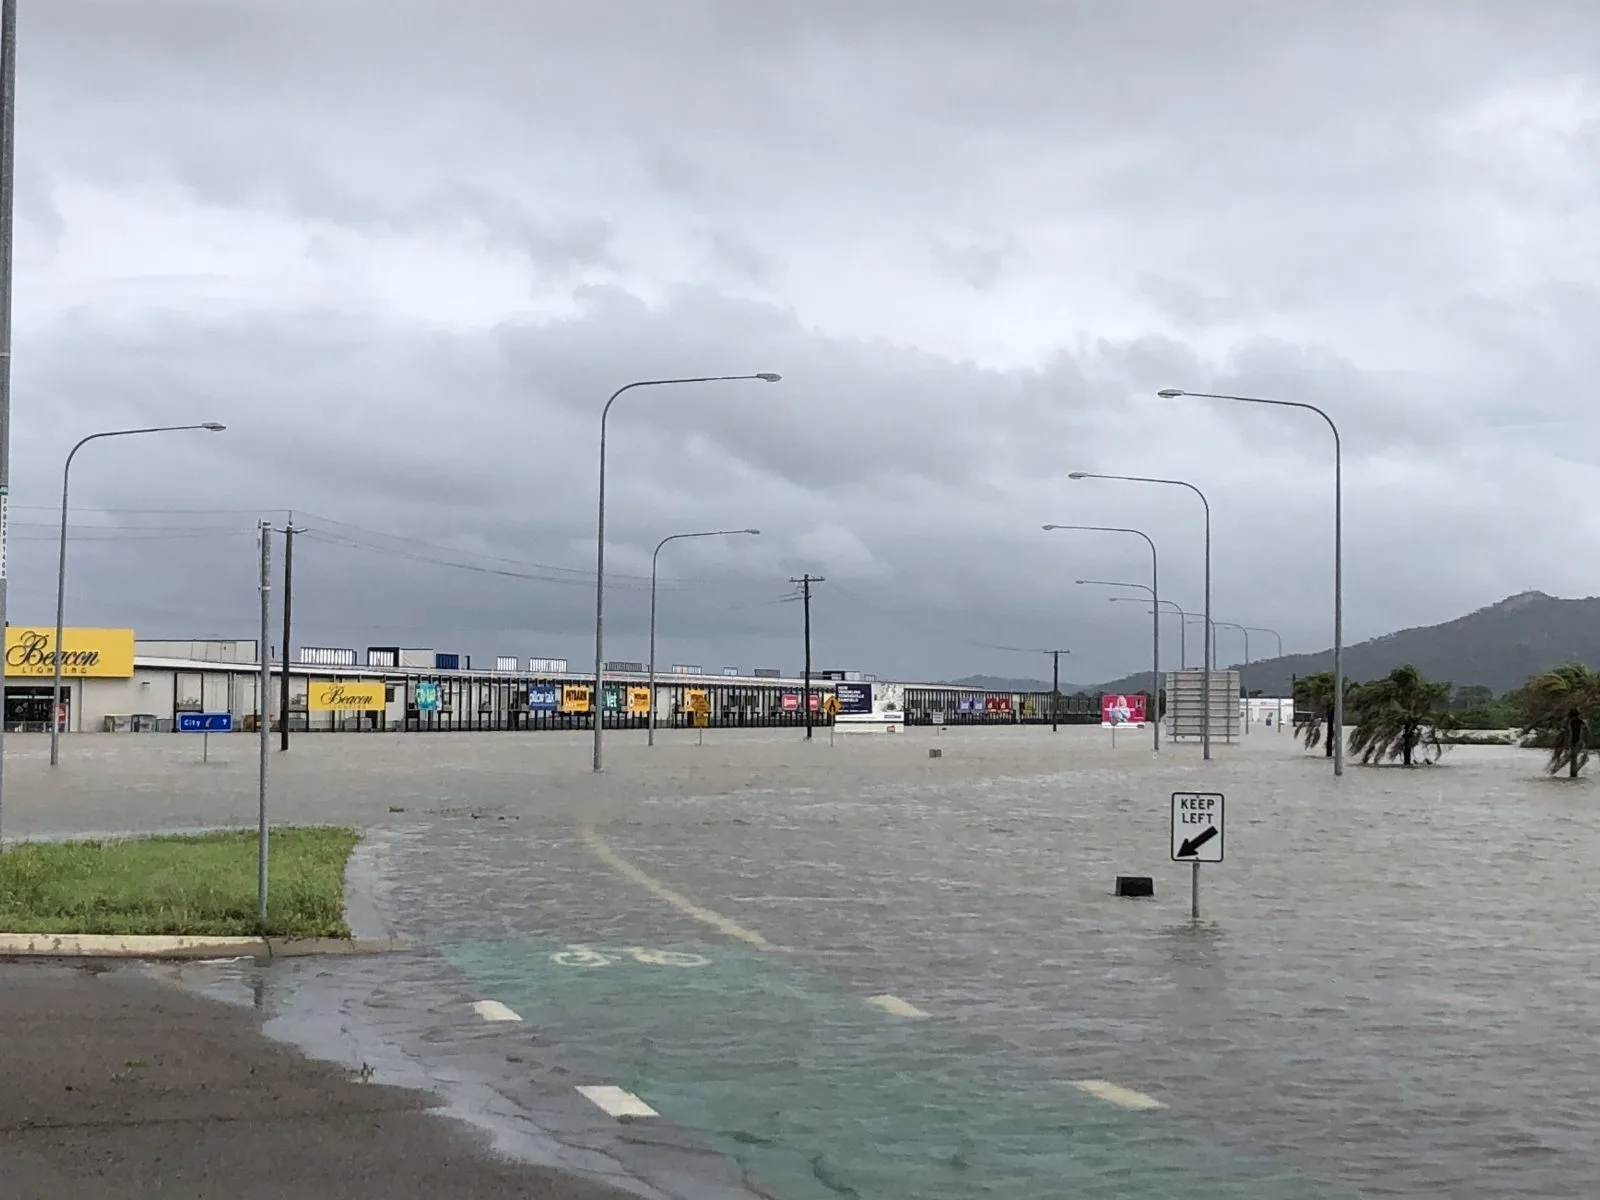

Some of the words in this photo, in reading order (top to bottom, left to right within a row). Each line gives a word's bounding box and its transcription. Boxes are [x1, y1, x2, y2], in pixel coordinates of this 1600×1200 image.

[6, 630, 100, 667] Beacon
[22, 666, 88, 675] LIGHING
[320, 684, 374, 706] Beacon
[606, 691, 618, 708] Vet
[184, 719, 201, 728] City
[1181, 798, 1216, 810] KEEP
[1182, 813, 1214, 824] LEFT
